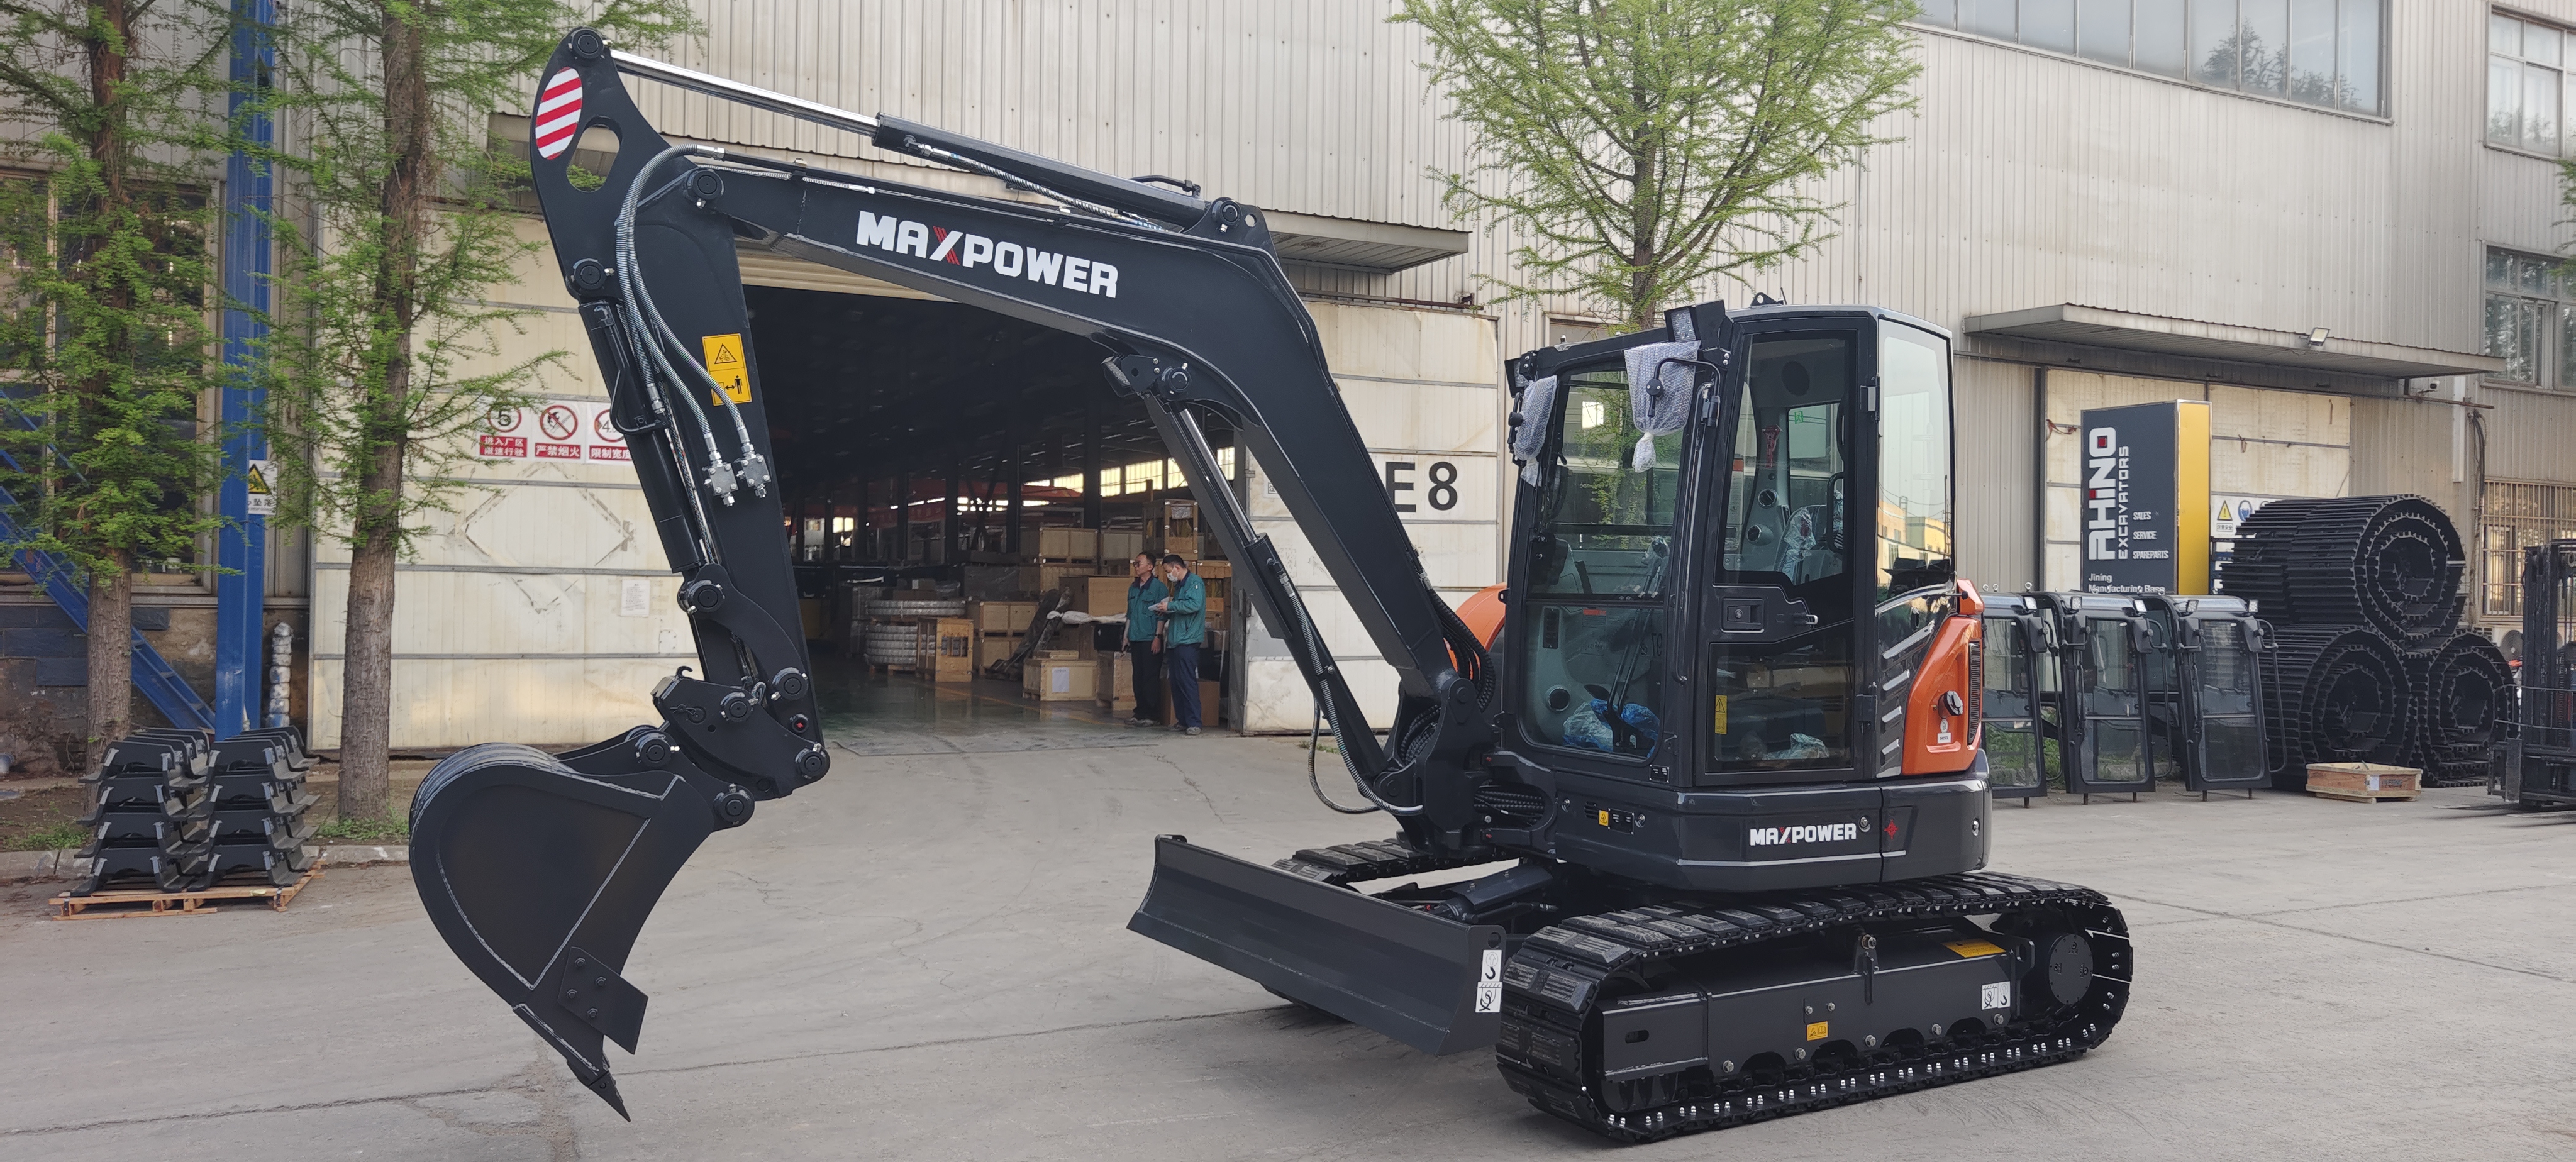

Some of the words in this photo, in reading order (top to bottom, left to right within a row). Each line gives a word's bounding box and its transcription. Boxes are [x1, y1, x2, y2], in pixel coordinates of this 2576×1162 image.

[856, 209, 1119, 299] MAXPOWER
[497, 407, 511, 426] 5
[536, 445, 580, 457] 严禁烟火
[1385, 461, 1458, 512] E8
[2088, 426, 2117, 561] RHINO
[2118, 446, 2129, 560] EXCAVATORS
[2133, 511, 2152, 521] SALES
[2133, 531, 2157, 540] SERVICE
[2133, 550, 2169, 560] SPAREPARTS
[2088, 573, 2112, 583] Jining
[2088, 584, 2143, 594] Manufacturing
[1749, 822, 1857, 846] MAXPOWER
